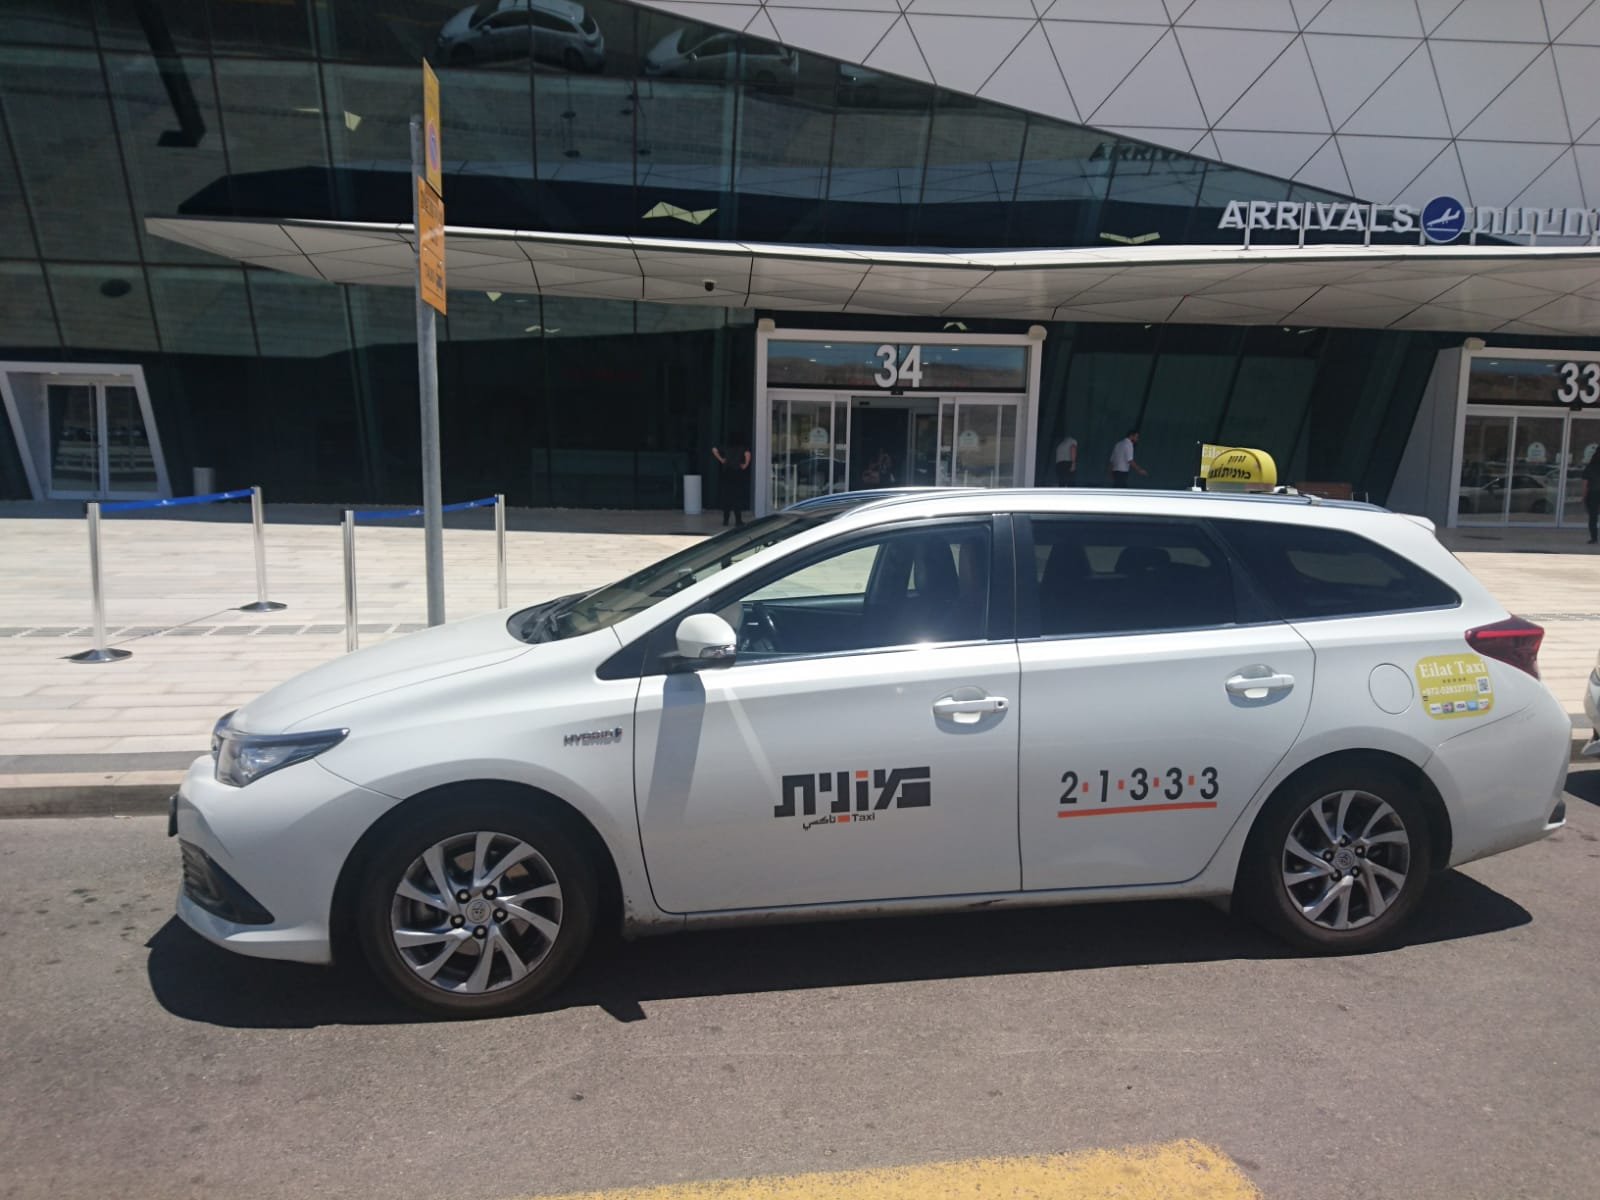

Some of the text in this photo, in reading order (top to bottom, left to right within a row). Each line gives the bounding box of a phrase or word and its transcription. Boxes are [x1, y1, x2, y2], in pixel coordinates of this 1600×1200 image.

[1218, 200, 1415, 233] ARRIVALS
[873, 344, 923, 388] 34
[1557, 362, 1600, 404] 33
[1419, 659, 1487, 678] Eilat Taxi
[852, 812, 876, 822] Taxi
